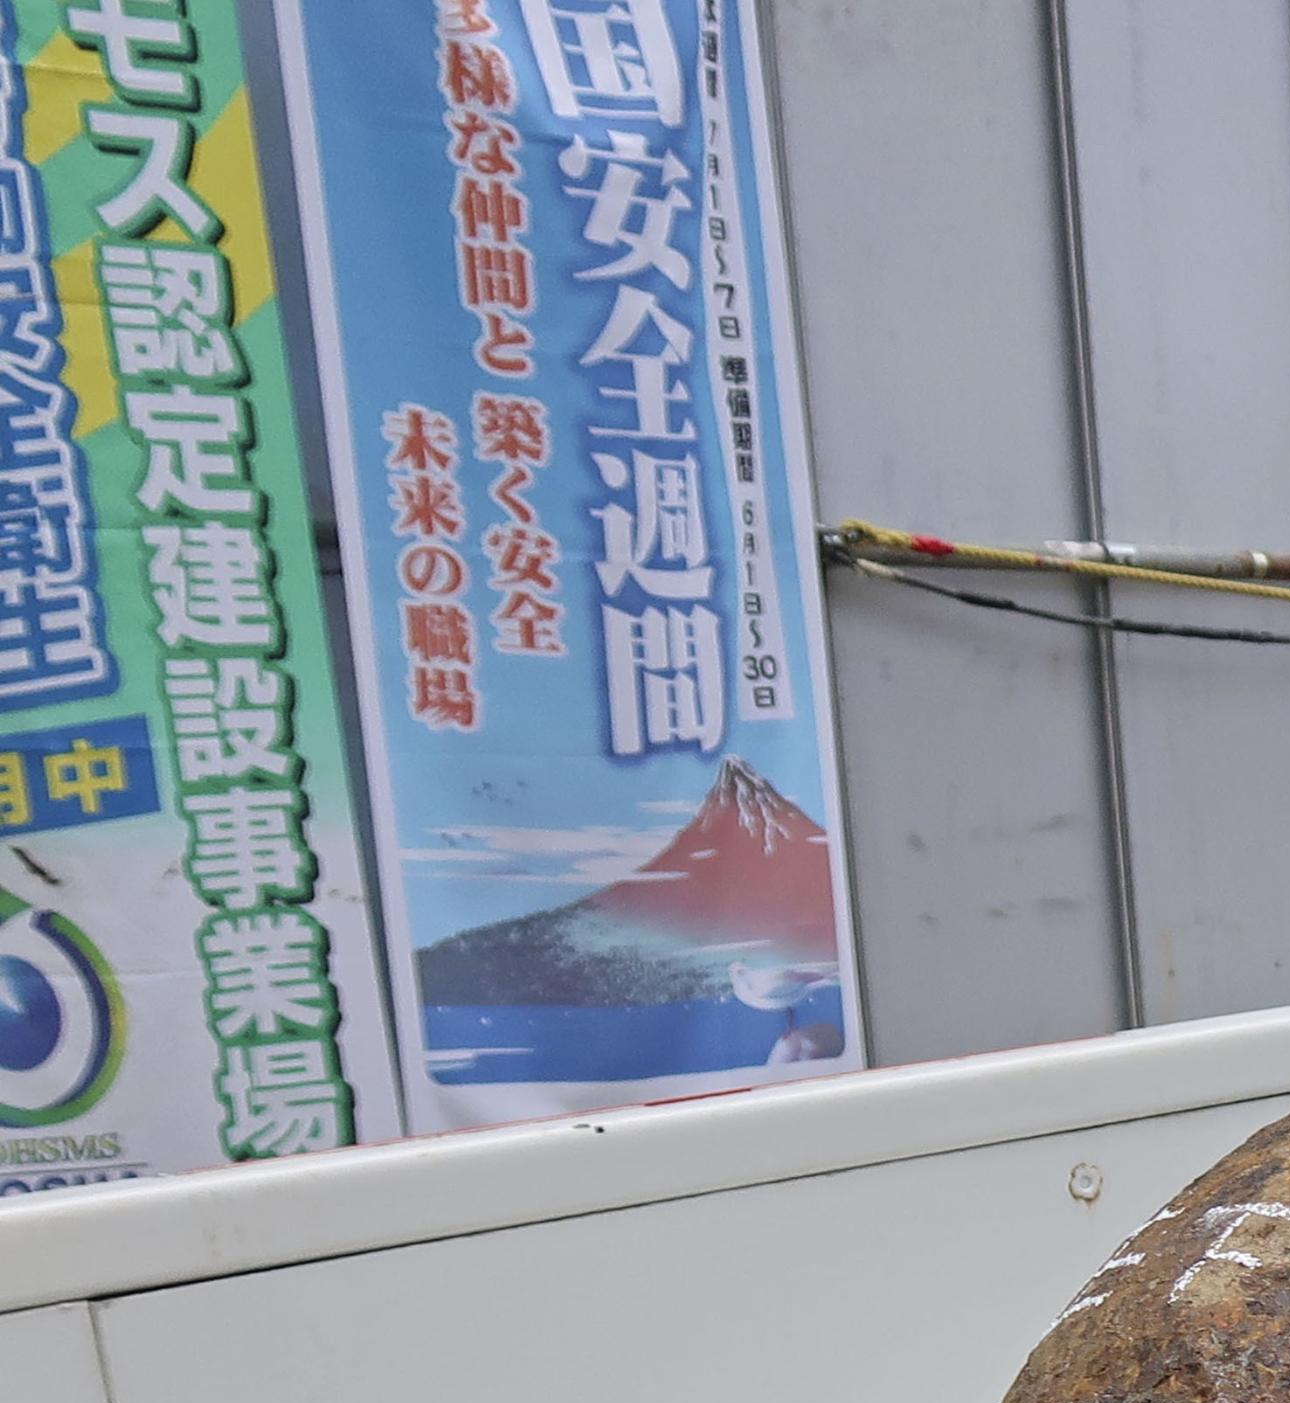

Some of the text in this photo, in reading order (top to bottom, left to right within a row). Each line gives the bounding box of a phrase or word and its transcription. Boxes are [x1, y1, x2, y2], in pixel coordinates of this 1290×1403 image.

[397, 409, 476, 728] 未来の職場
[479, 397, 557, 651] 築く安全
